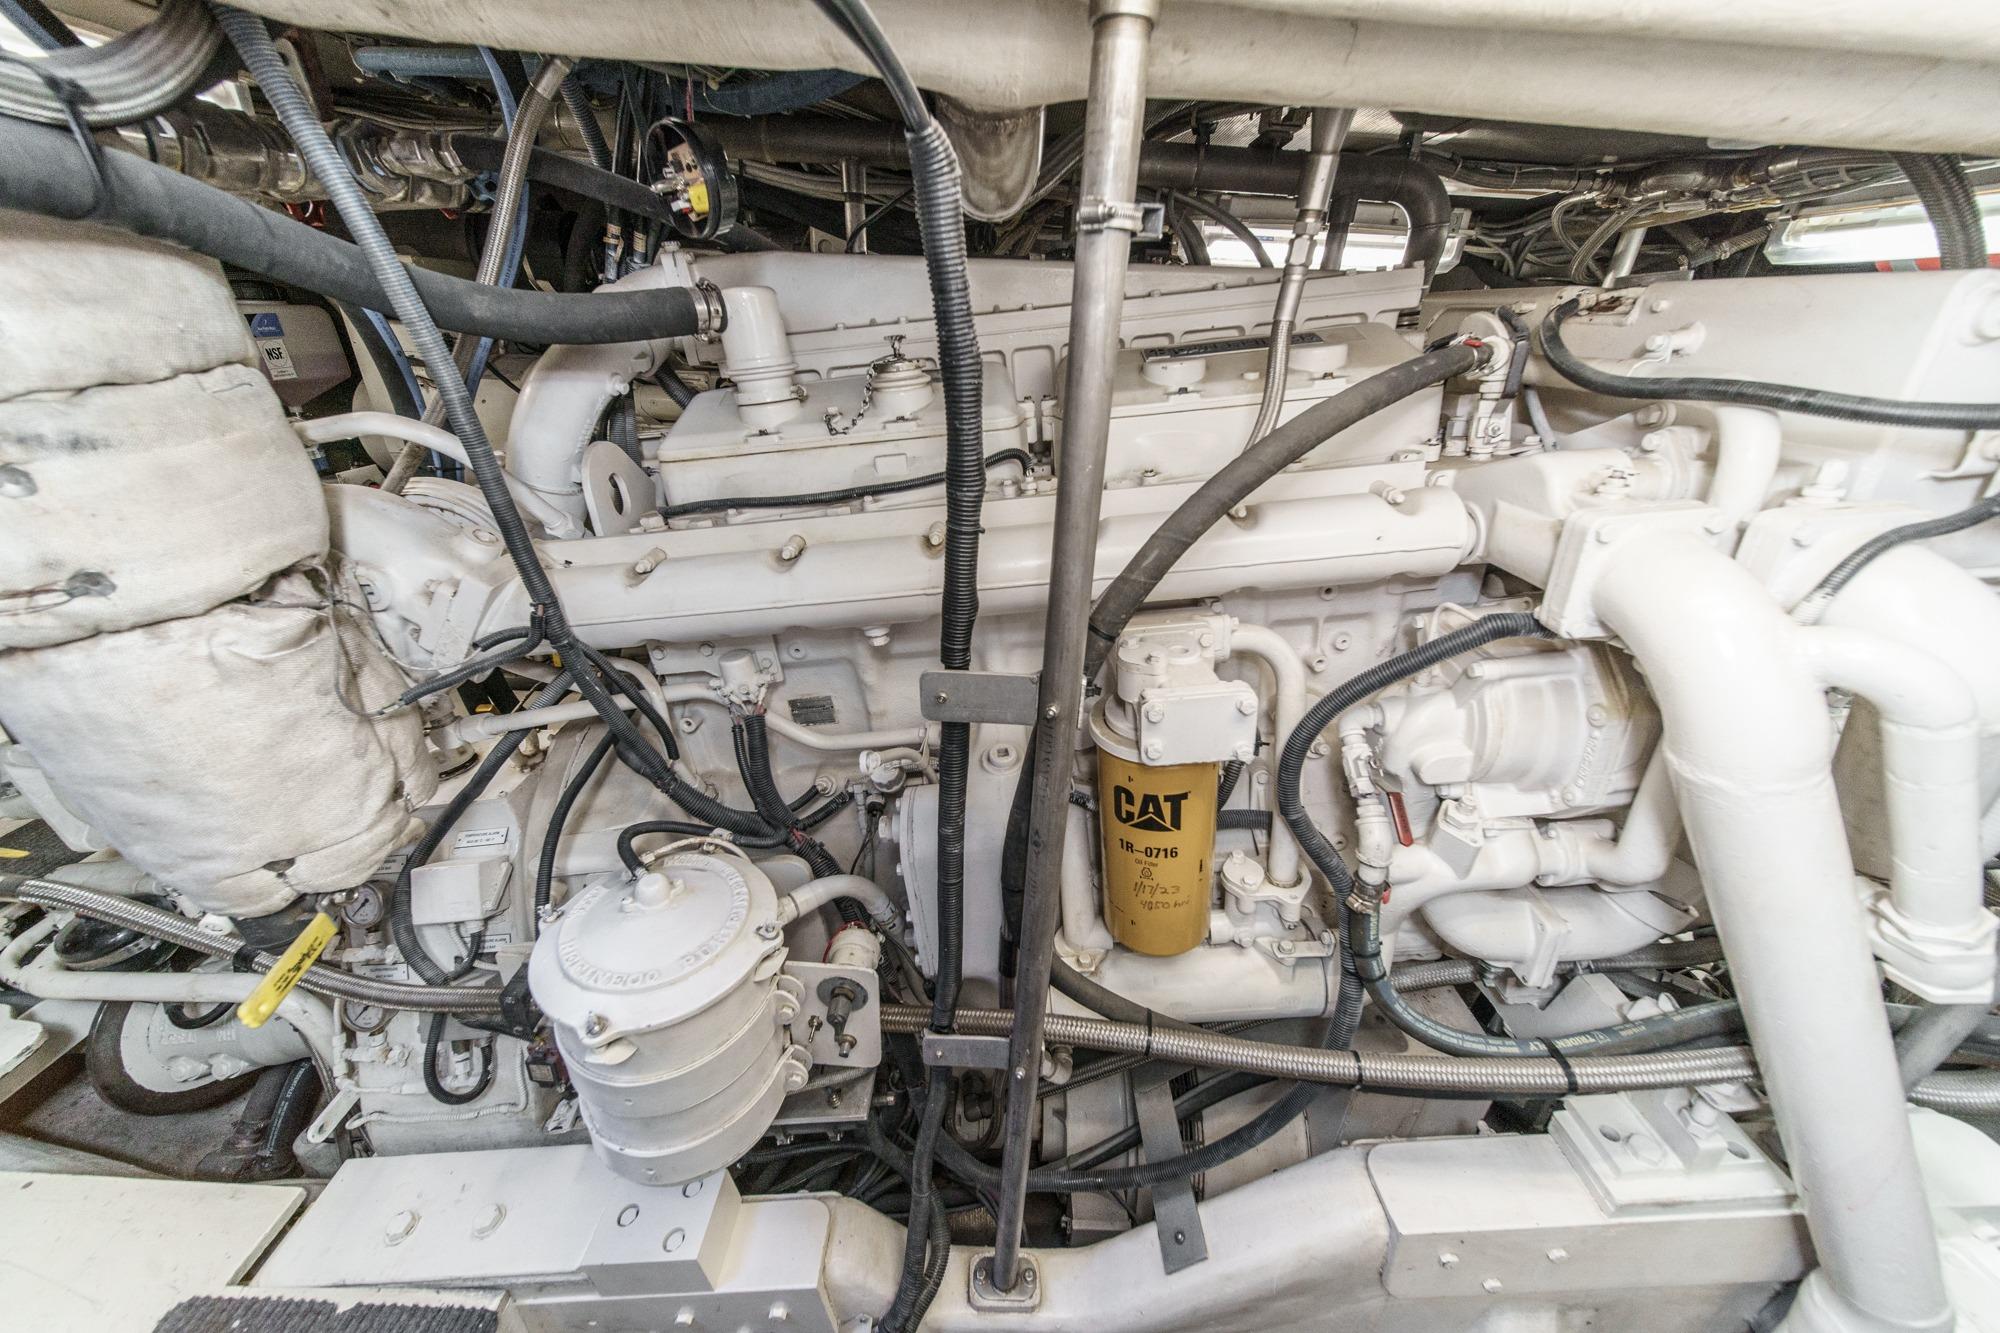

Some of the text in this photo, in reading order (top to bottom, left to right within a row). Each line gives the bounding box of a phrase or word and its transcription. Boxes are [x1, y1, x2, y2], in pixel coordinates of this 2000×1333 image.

[265, 347, 283, 360] NSF
[1114, 785, 1188, 831] CAT
[1119, 839, 1178, 859] 1R-0716
[1133, 881, 1180, 898] 1/17/23
